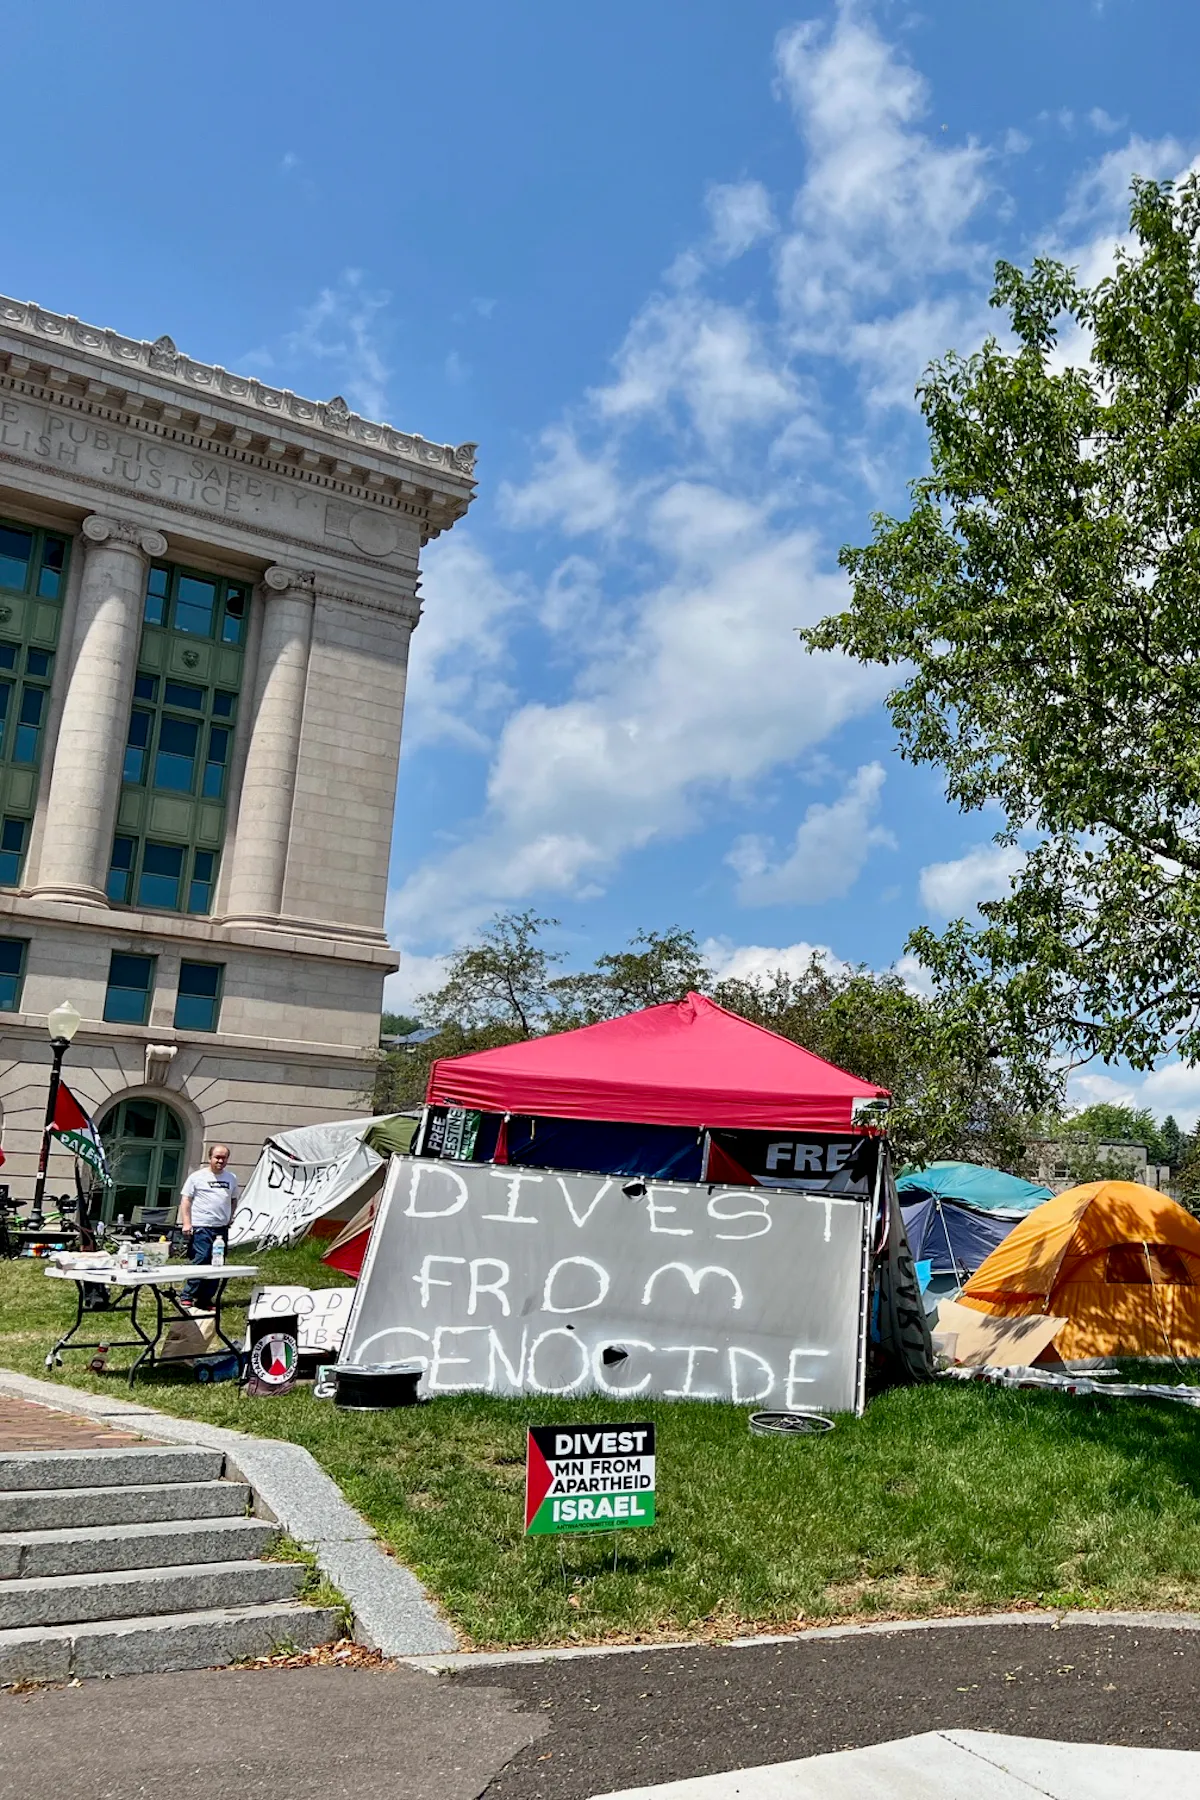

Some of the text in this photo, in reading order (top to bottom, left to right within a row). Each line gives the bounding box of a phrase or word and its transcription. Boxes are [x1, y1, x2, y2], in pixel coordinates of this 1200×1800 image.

[47, 416, 167, 470] PUBLIC
[427, 1116, 446, 1150] FREE
[766, 1143, 852, 1172] FRE
[403, 1163, 857, 1242] DIVEST
[412, 1255, 743, 1316] FROM
[254, 1292, 343, 1315] FOOD
[555, 1431, 648, 1456] DIVEST
[555, 1458, 641, 1476] MN FROM
[552, 1475, 651, 1494] APARTHEID
[553, 1495, 646, 1522] ISRAEL
